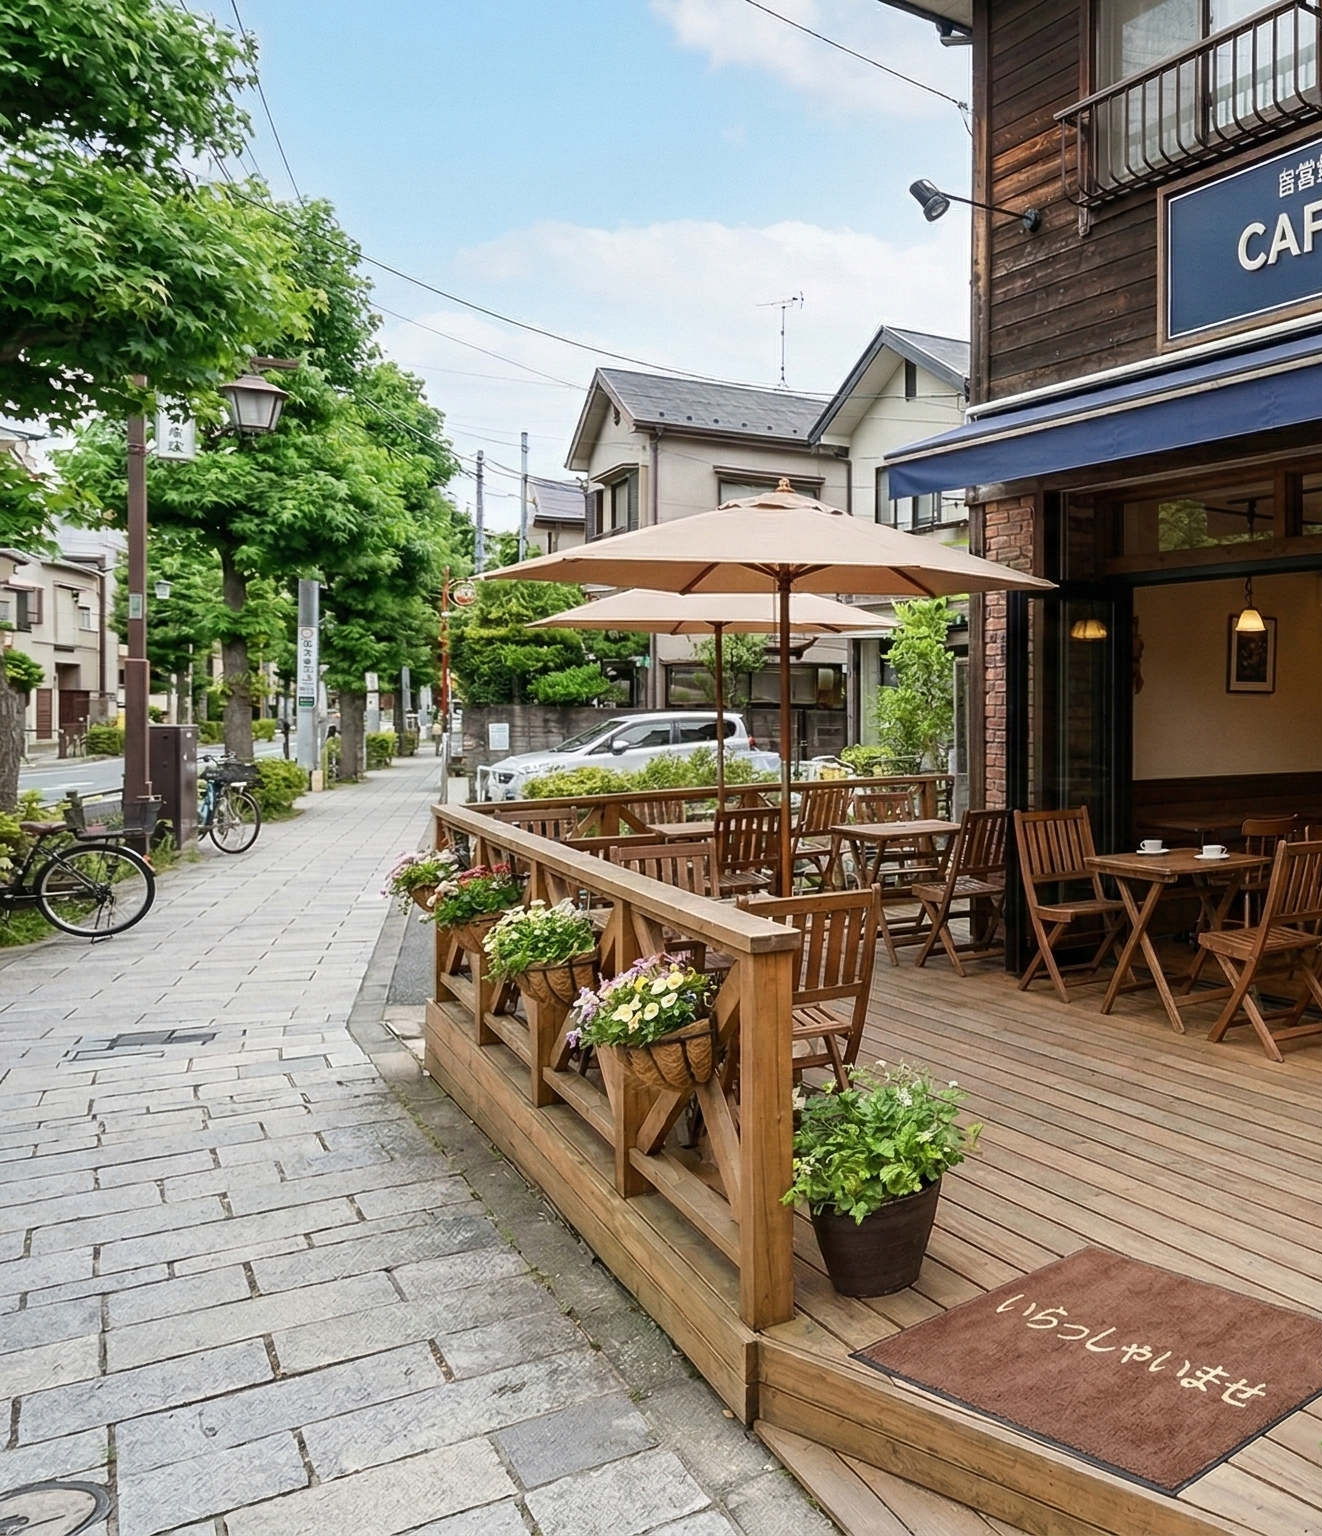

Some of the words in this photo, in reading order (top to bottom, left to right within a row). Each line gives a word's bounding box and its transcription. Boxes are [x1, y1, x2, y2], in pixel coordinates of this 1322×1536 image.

[996, 1294, 1266, 1408] いらっしゃいませ
